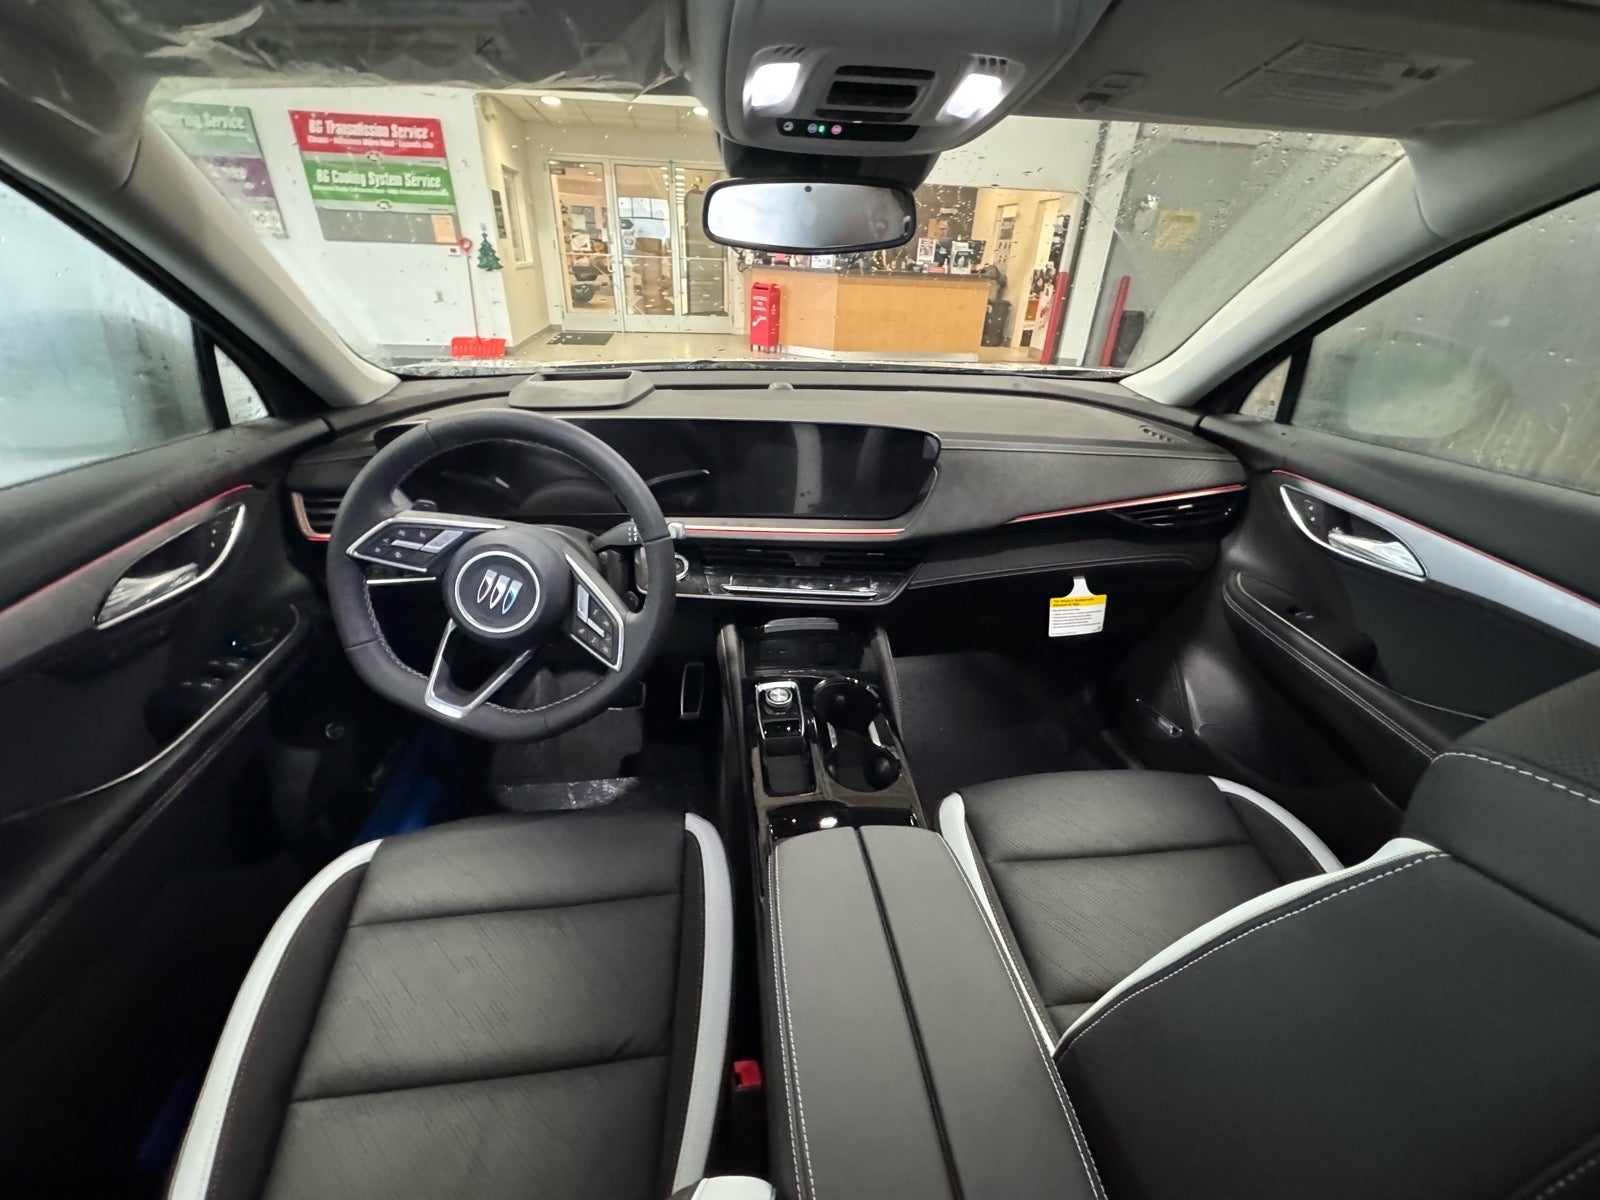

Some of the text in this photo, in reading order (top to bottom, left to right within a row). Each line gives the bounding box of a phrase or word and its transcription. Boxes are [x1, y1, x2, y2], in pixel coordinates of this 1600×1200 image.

[202, 112, 246, 130] Service
[308, 119, 429, 139] BG Transmission Service
[316, 169, 442, 188] BG Cooling System Service
